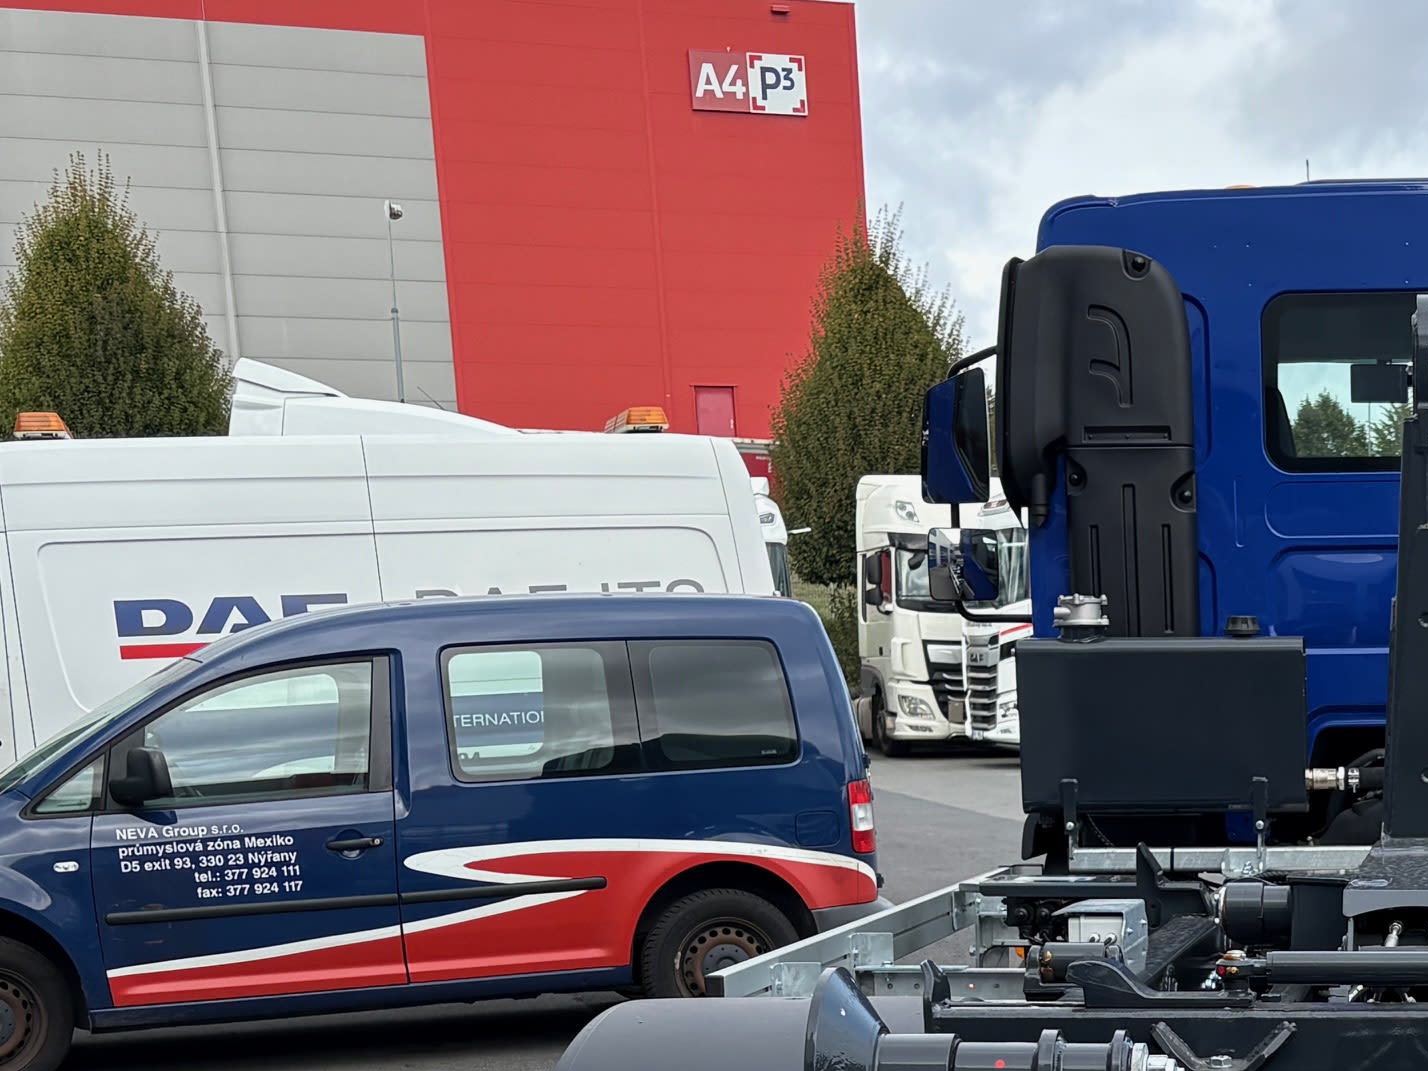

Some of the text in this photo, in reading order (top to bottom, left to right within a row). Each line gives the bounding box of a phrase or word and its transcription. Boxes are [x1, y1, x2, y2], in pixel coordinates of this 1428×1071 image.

[696, 63, 747, 99] A4
[116, 824, 244, 840] NEVA Group s.r.o.
[118, 835, 294, 859] průmyslová zóna Mexiko
[120, 852, 297, 873] D5 exit 93, 330 23 Nýřany
[194, 865, 300, 882] tel.: 377 924 111
[197, 881, 303, 898] fax: 377 924 117
